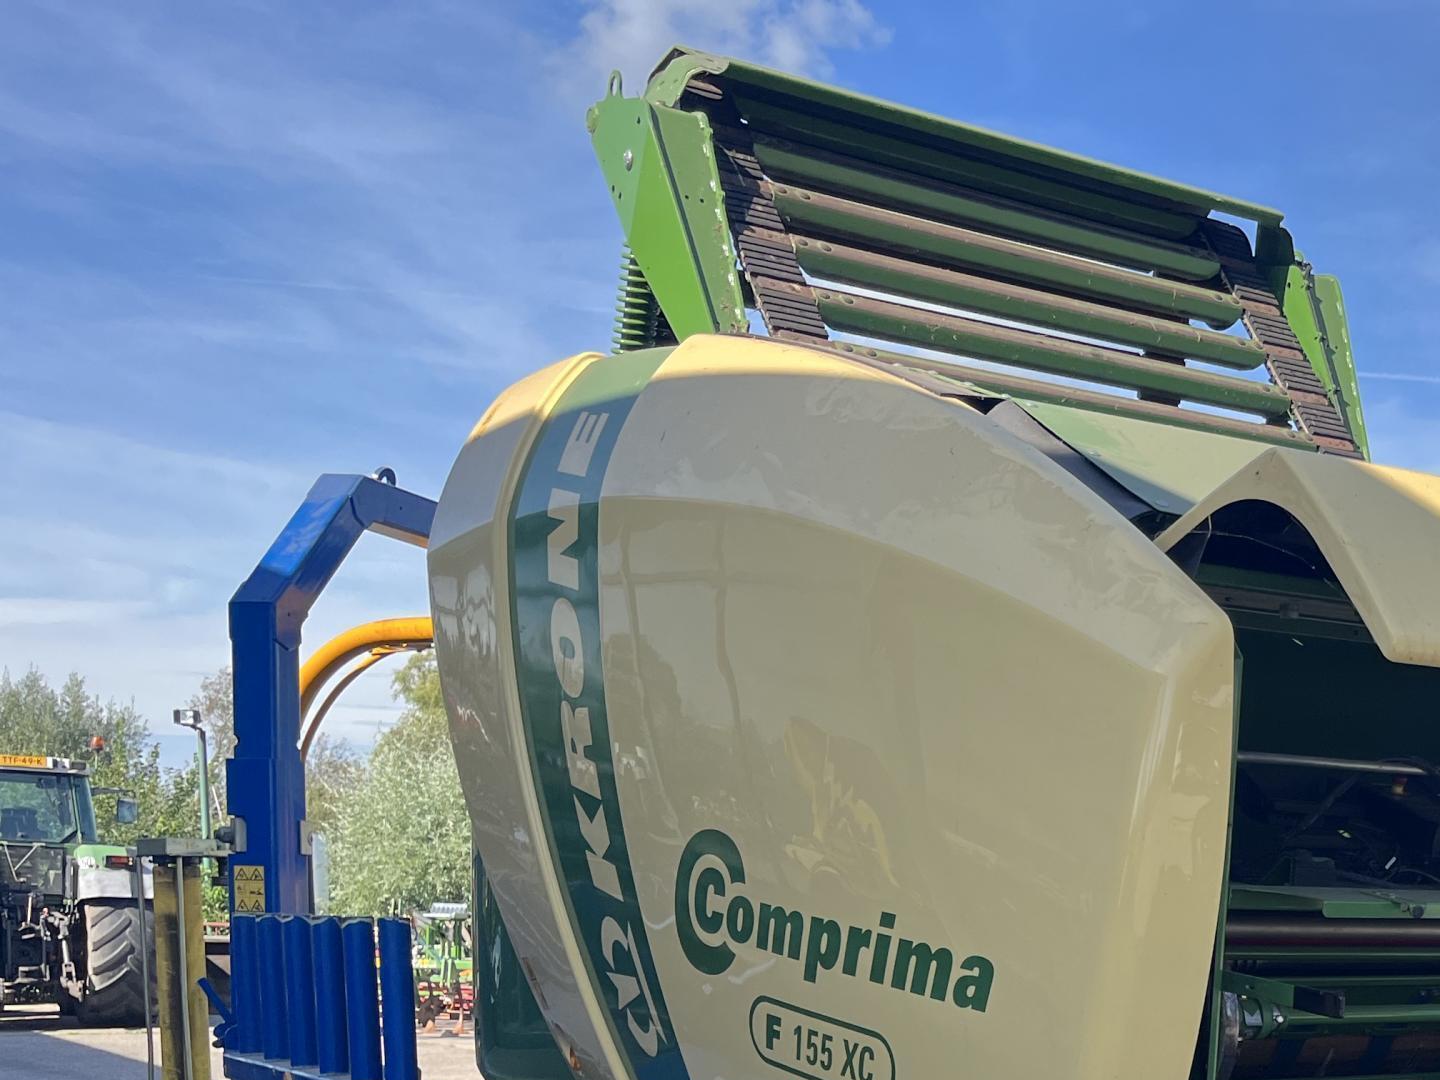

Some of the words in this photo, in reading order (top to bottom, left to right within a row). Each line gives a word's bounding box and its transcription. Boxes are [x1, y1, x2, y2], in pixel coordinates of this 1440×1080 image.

[546, 411, 624, 902] KRONE
[675, 829, 995, 1013] Comprima
[765, 1013, 782, 1051] F
[793, 1024, 833, 1071] 155
